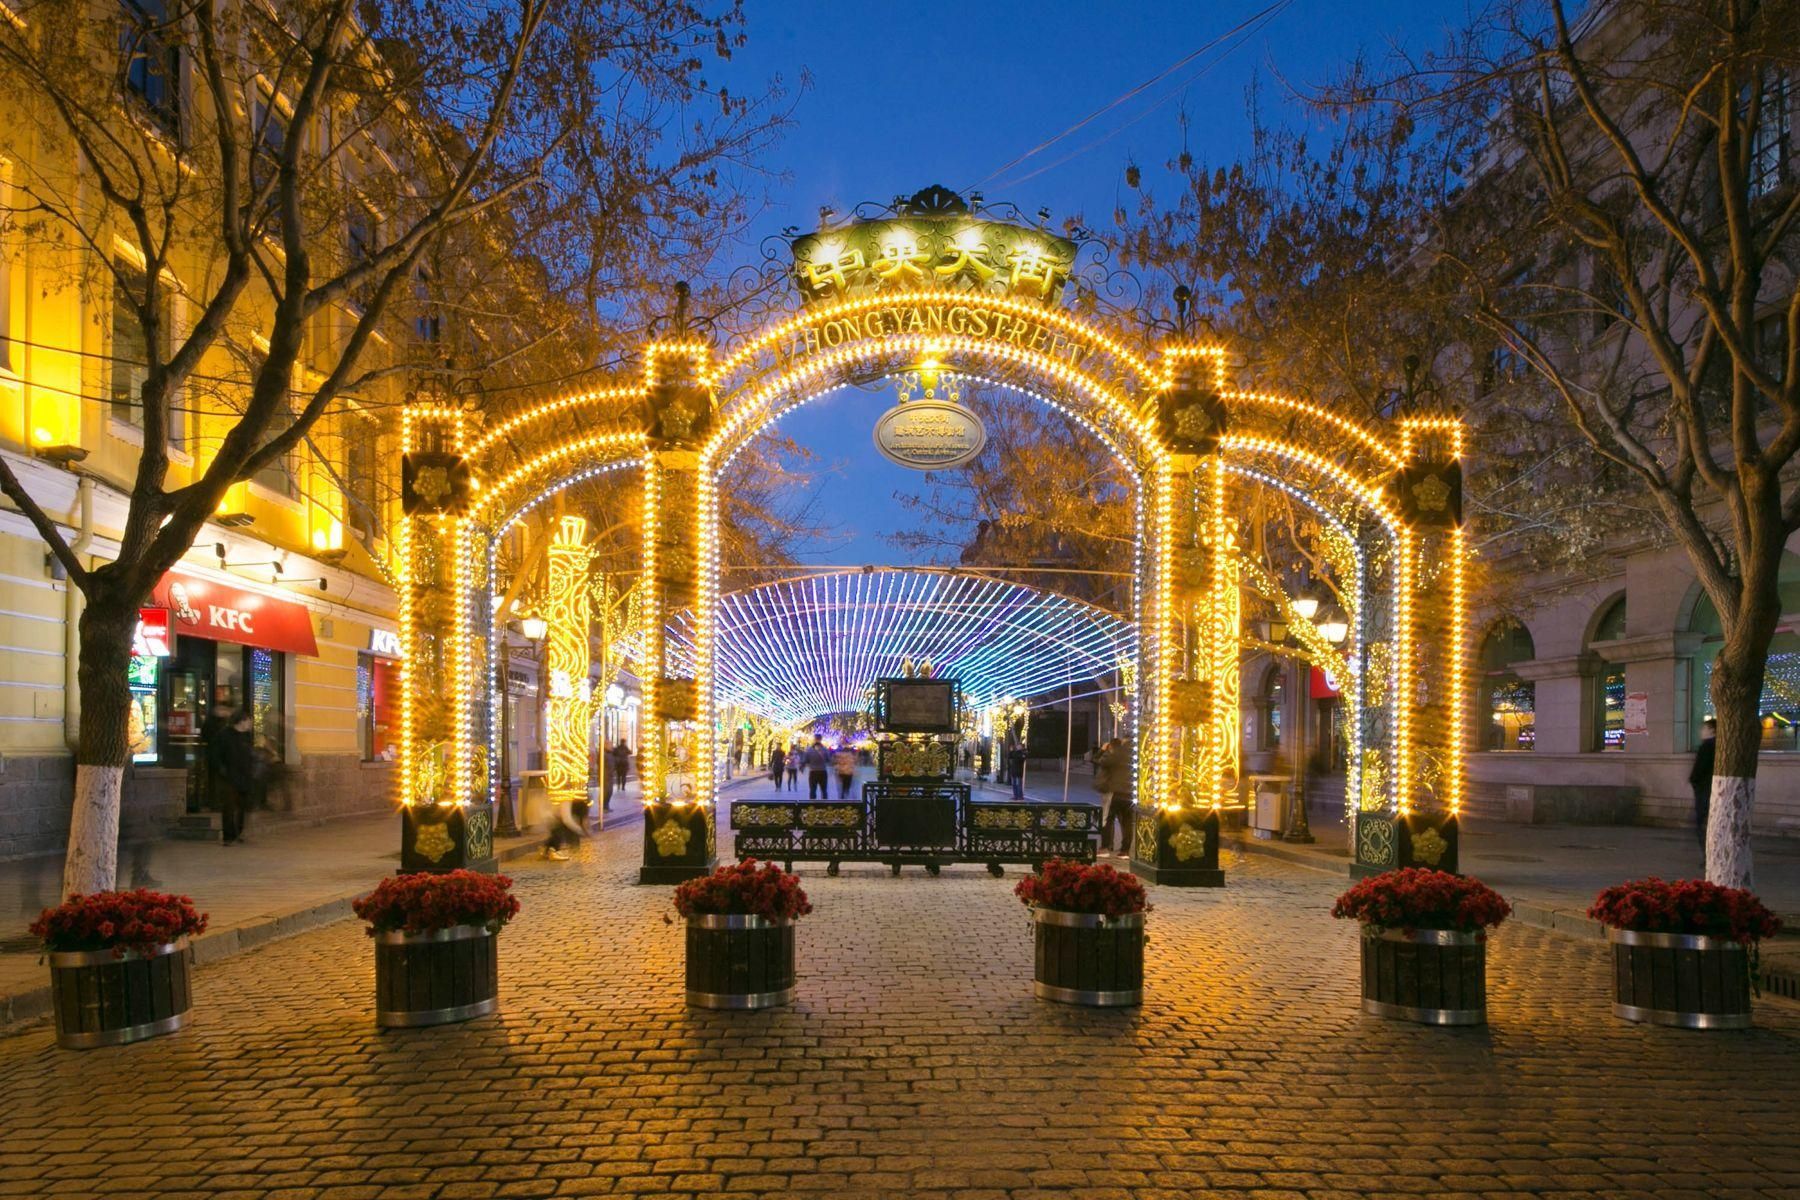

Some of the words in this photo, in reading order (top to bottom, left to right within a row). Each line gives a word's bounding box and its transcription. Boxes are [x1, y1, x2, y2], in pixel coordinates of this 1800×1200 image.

[806, 242, 1067, 295] 中央大街
[209, 605, 253, 633] KFC
